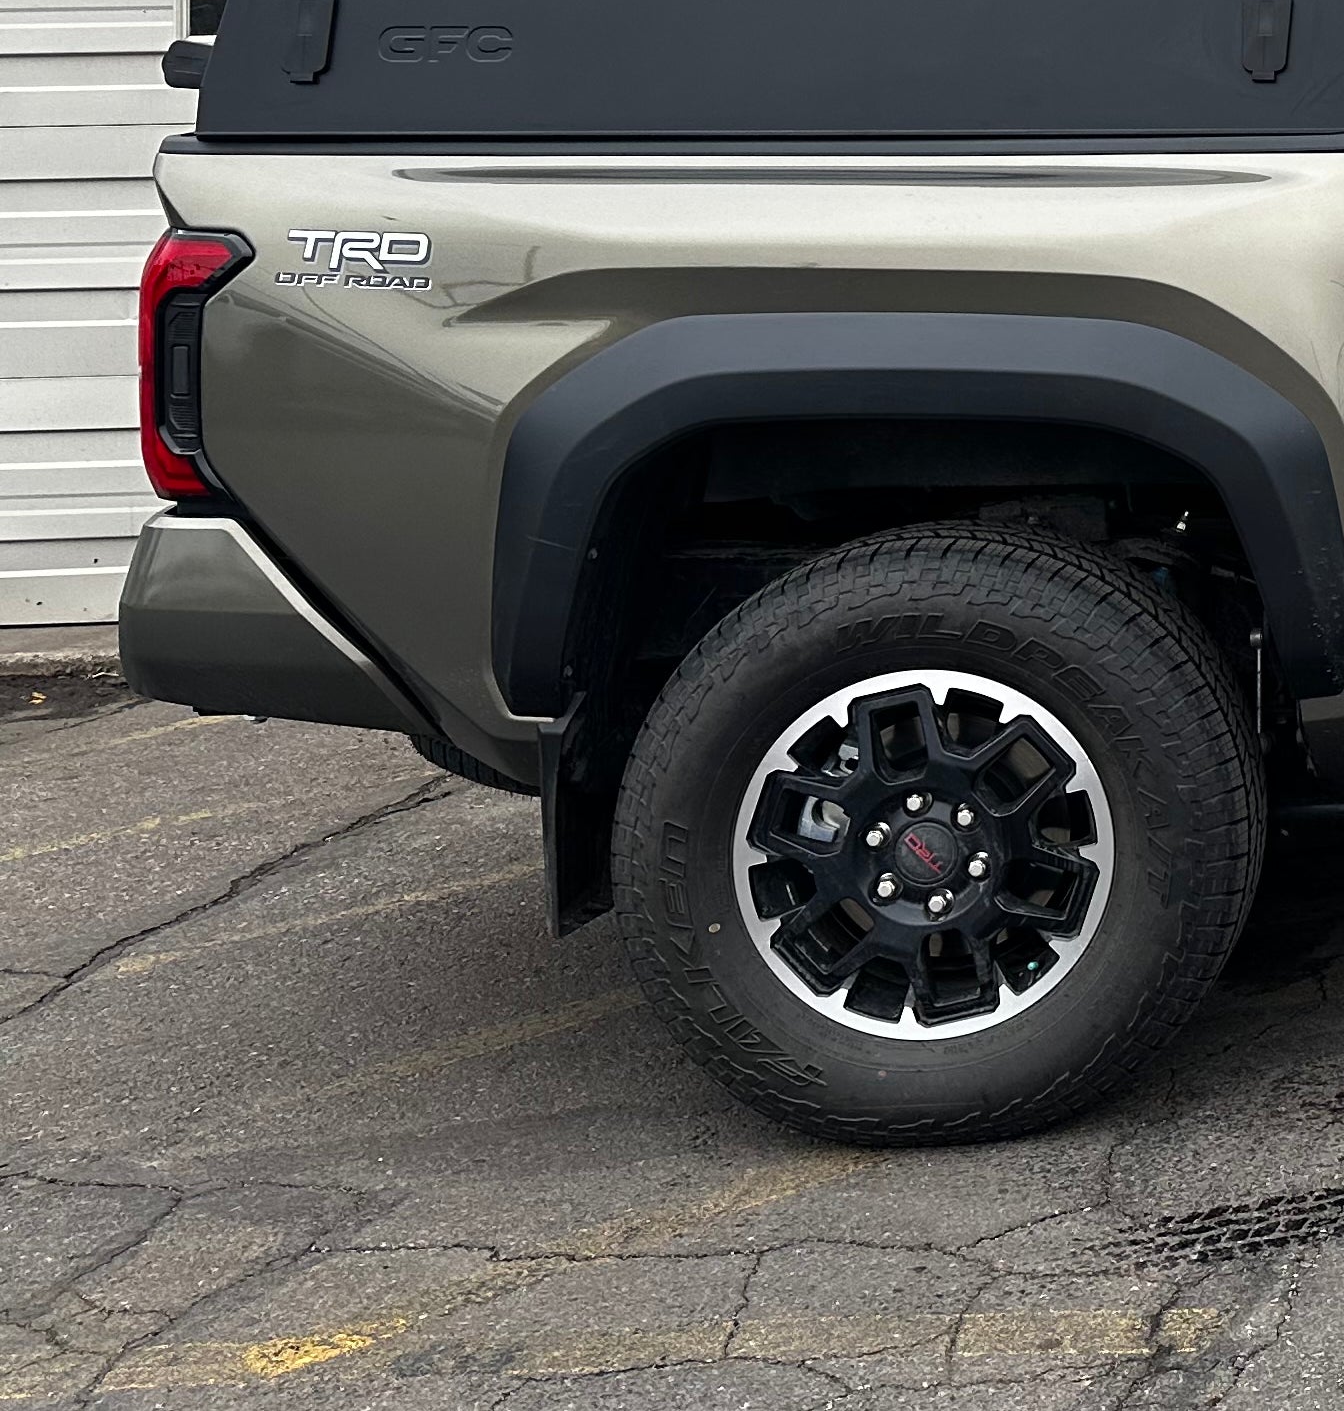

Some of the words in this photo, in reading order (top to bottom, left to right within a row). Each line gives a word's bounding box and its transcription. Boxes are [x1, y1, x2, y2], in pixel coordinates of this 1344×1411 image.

[377, 25, 514, 63] GFC
[288, 228, 432, 274] TRD
[274, 271, 340, 288] OFF
[343, 274, 432, 291] ROAD
